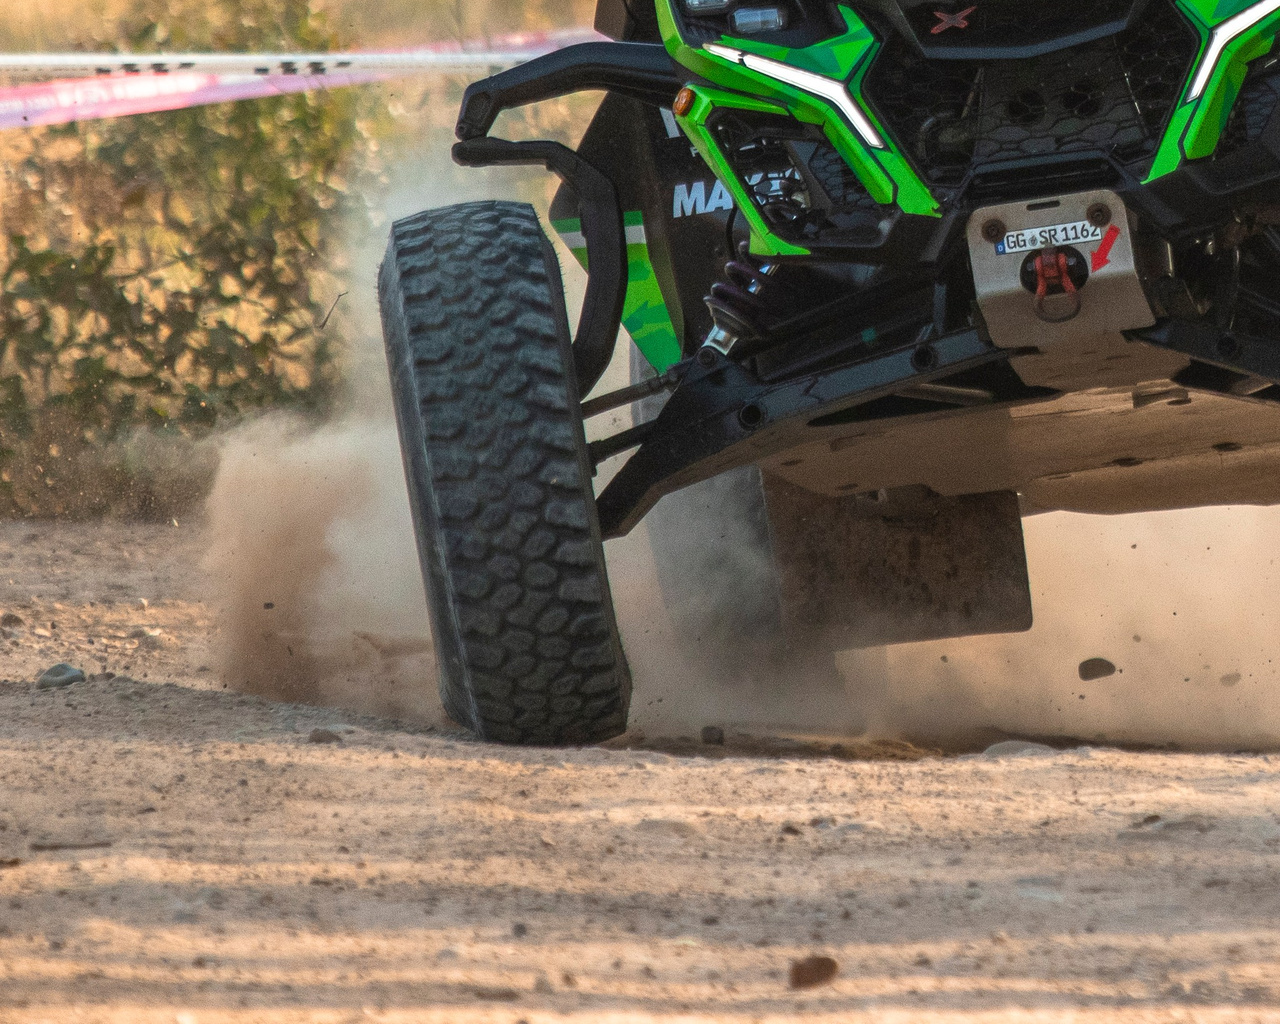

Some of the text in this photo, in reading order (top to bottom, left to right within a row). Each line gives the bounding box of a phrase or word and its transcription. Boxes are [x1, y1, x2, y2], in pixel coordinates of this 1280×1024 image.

[1005, 232, 1027, 250] GG
[1038, 228, 1060, 245] SR
[1060, 223, 1100, 243] 1162
